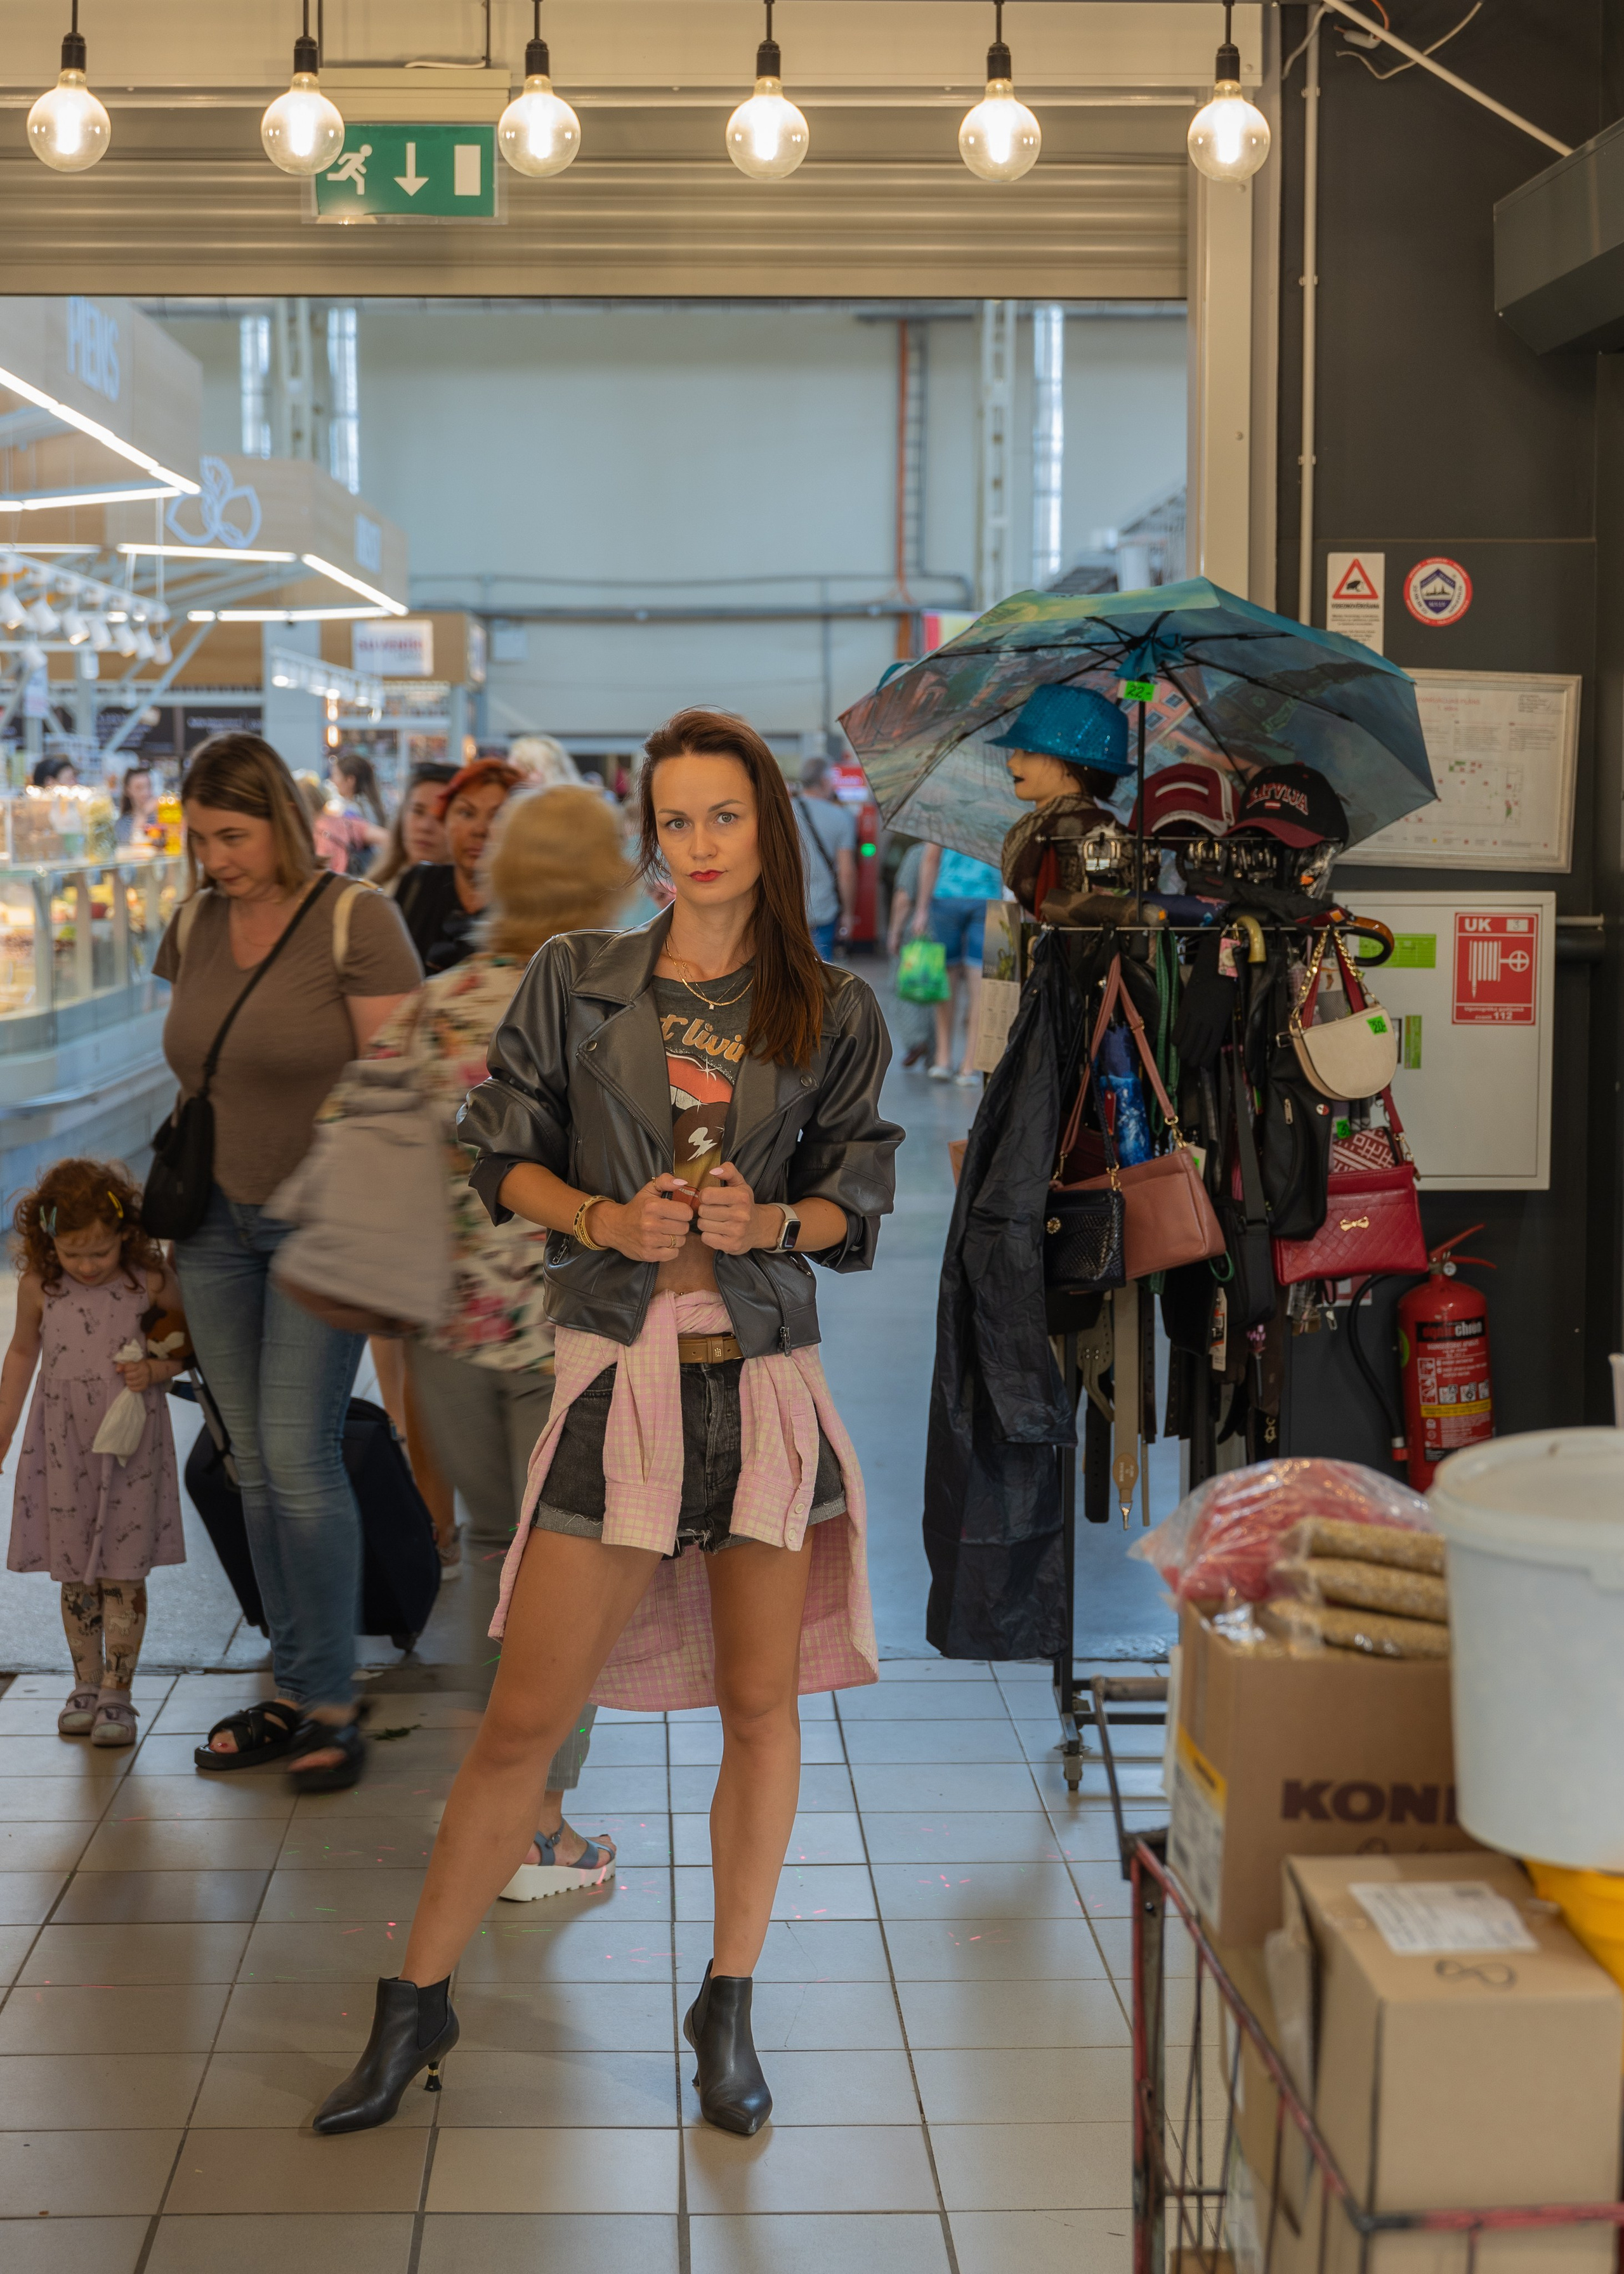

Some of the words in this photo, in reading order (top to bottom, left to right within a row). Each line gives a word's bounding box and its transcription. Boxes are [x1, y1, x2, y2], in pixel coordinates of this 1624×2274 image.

[1464, 918, 1491, 932] UK
[1493, 1012, 1512, 1020] 112
[660, 1014, 688, 1040] t
